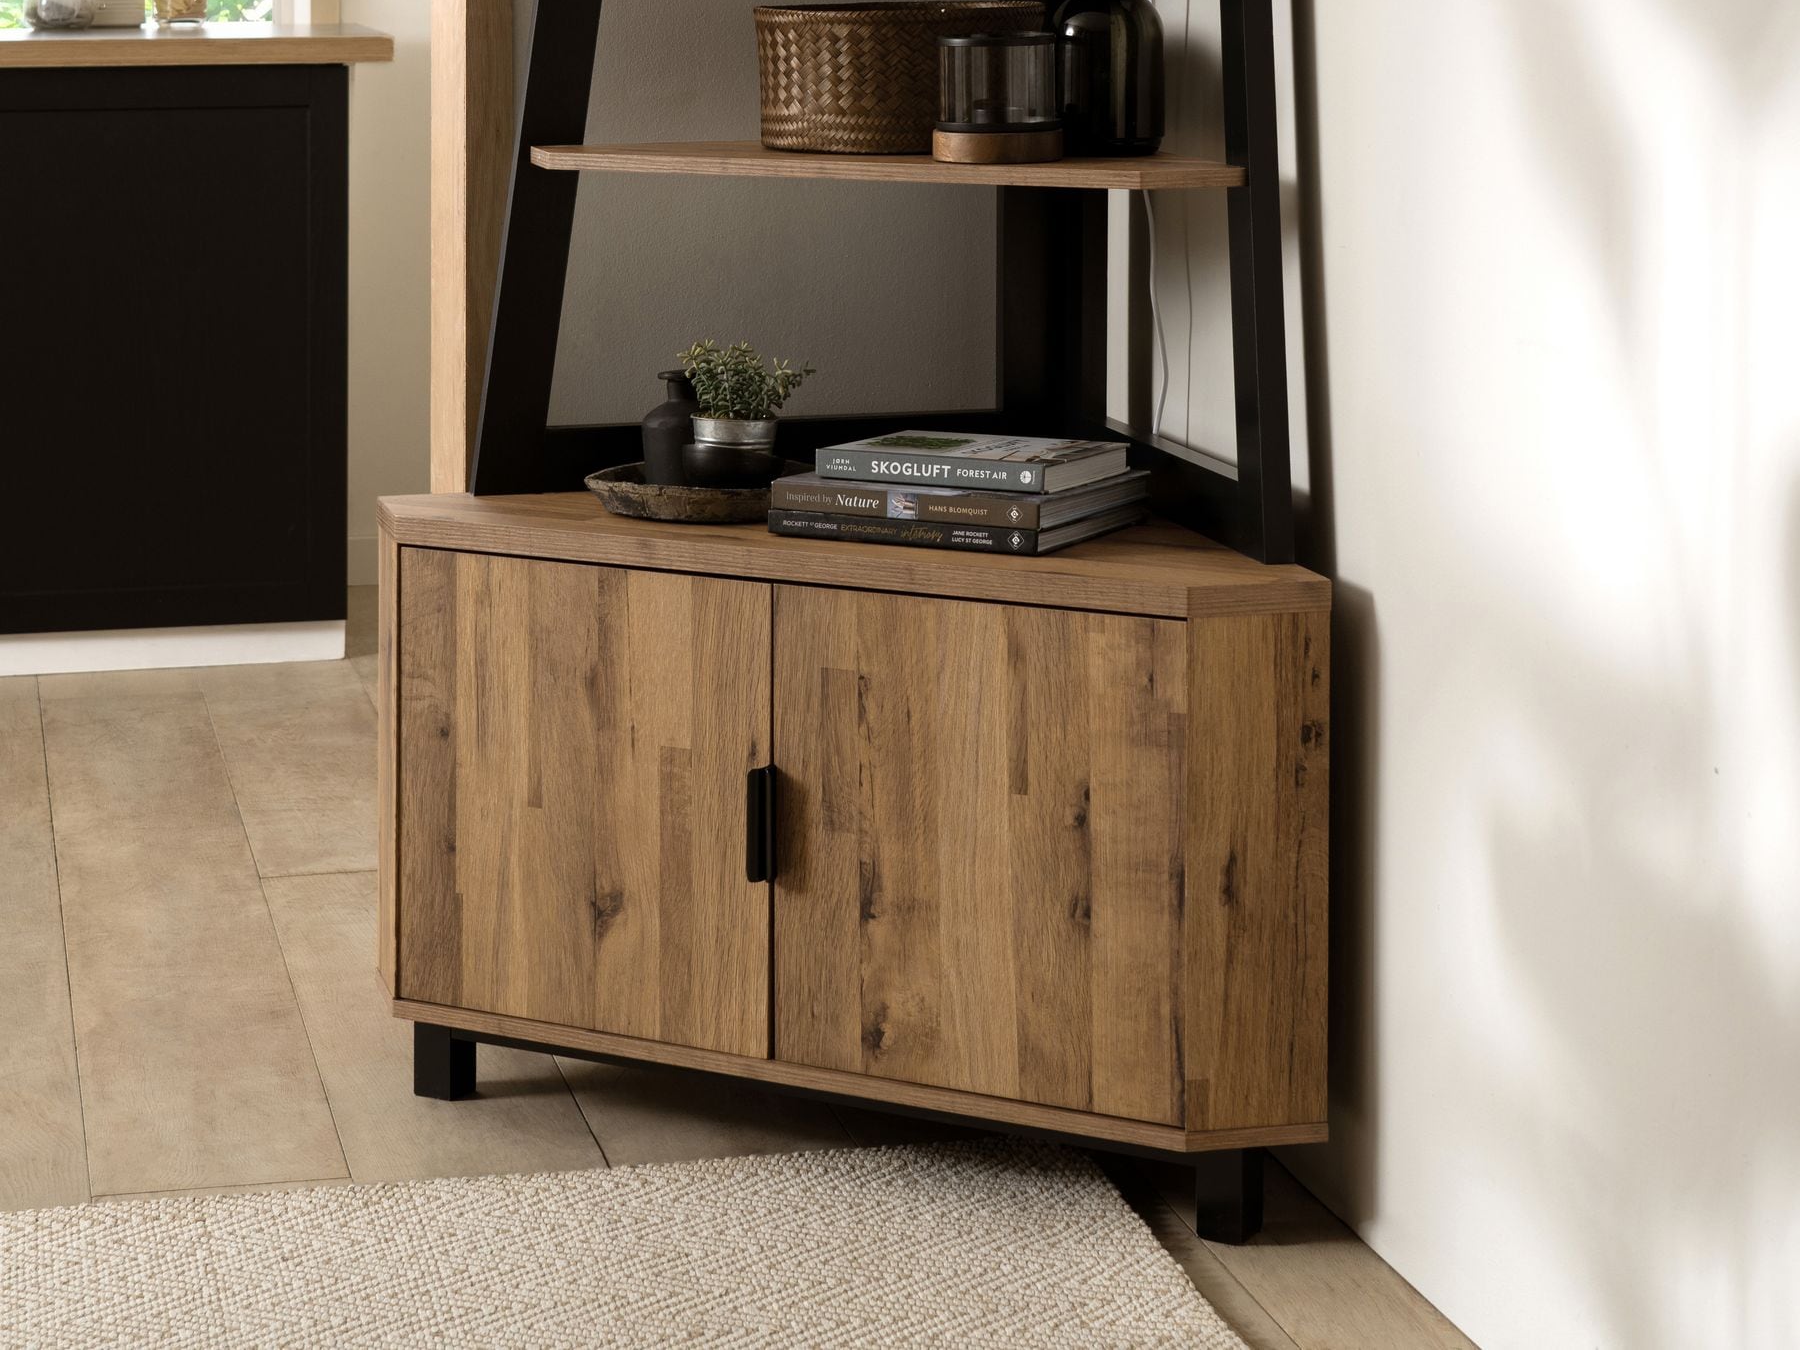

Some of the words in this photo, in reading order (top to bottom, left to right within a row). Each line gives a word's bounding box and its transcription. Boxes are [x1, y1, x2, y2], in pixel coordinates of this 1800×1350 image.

[871, 460, 952, 479] SKOGLUFT
[956, 468, 991, 479] FOREST
[991, 471, 1008, 480] AIR
[786, 491, 821, 504] Inspired
[822, 494, 833, 506] by
[835, 494, 880, 509] Nature
[928, 505, 948, 513] HANS
[949, 507, 988, 516] BLOMQUIST
[782, 520, 809, 528] ROCKETT
[814, 522, 838, 530] GEORGE
[965, 531, 989, 539] ROCKETT
